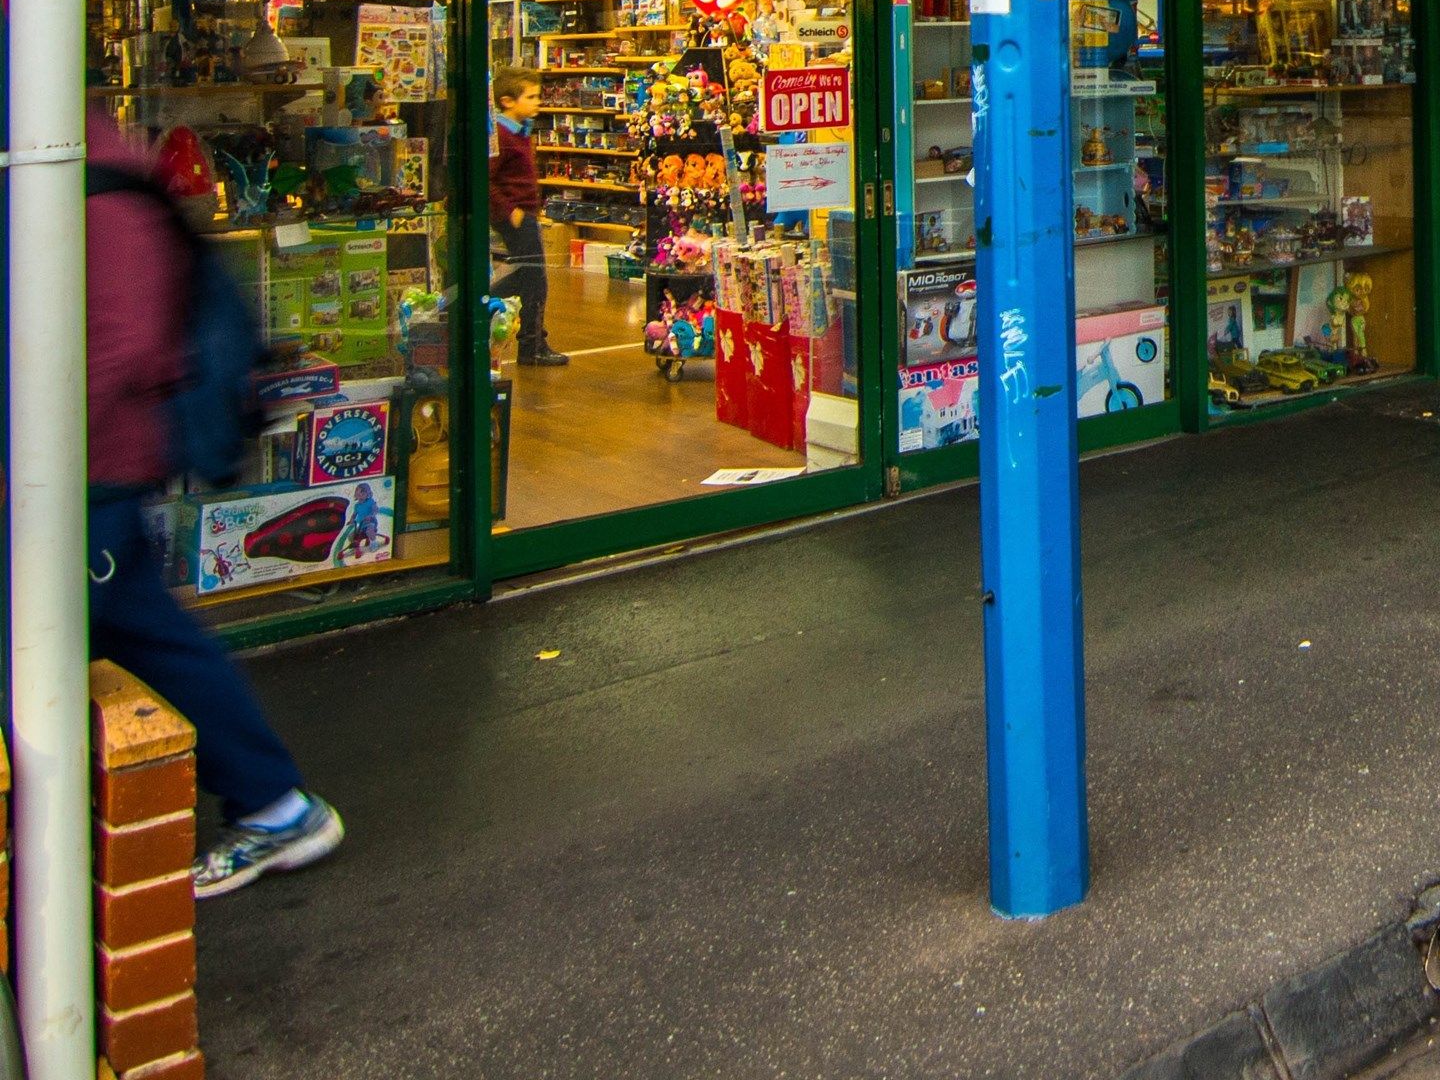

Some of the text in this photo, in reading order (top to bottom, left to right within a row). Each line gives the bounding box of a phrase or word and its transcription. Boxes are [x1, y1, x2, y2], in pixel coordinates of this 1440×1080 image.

[799, 26, 835, 37] Schleich
[771, 75, 803, 92] Come
[771, 91, 843, 126] OPEN
[908, 274, 935, 287] MIO
[935, 273, 967, 283] ROBOT
[899, 361, 979, 389] Fantas
[319, 409, 382, 440] OVERSEAS
